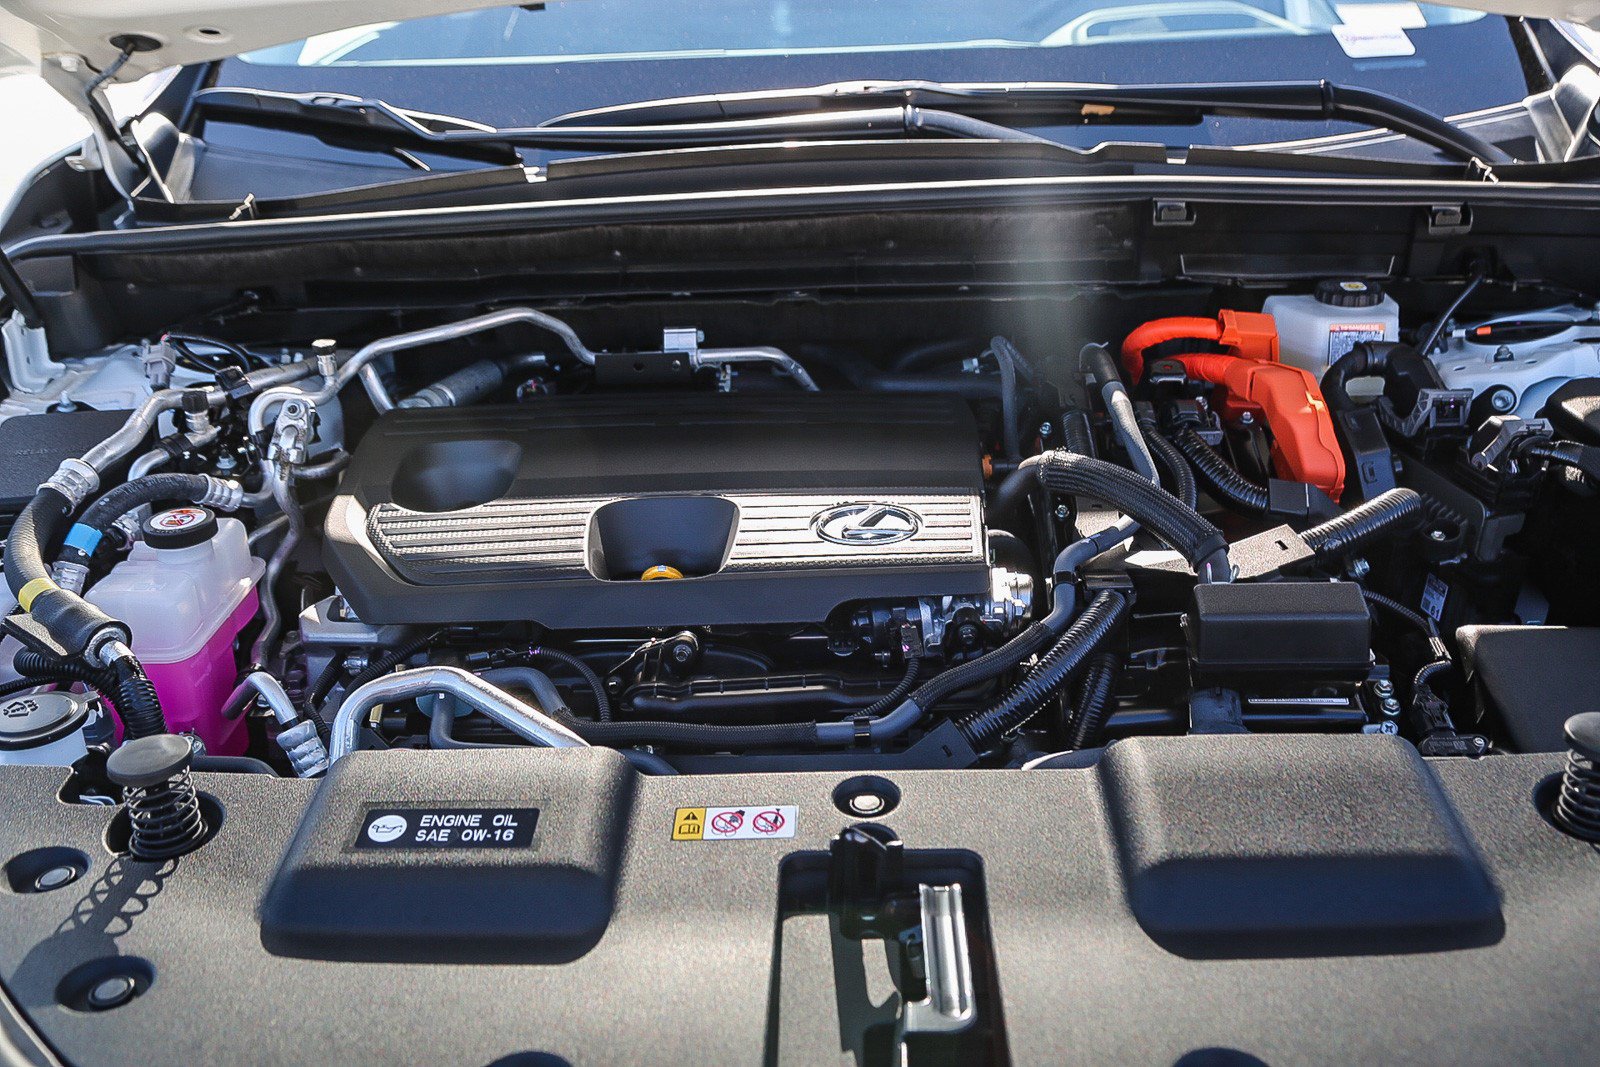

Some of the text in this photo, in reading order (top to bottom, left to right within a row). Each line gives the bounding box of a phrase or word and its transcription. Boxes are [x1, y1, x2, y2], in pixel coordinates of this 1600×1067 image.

[420, 814, 518, 827] ENGINE OIL
[415, 829, 515, 842] SAE 0W-16
